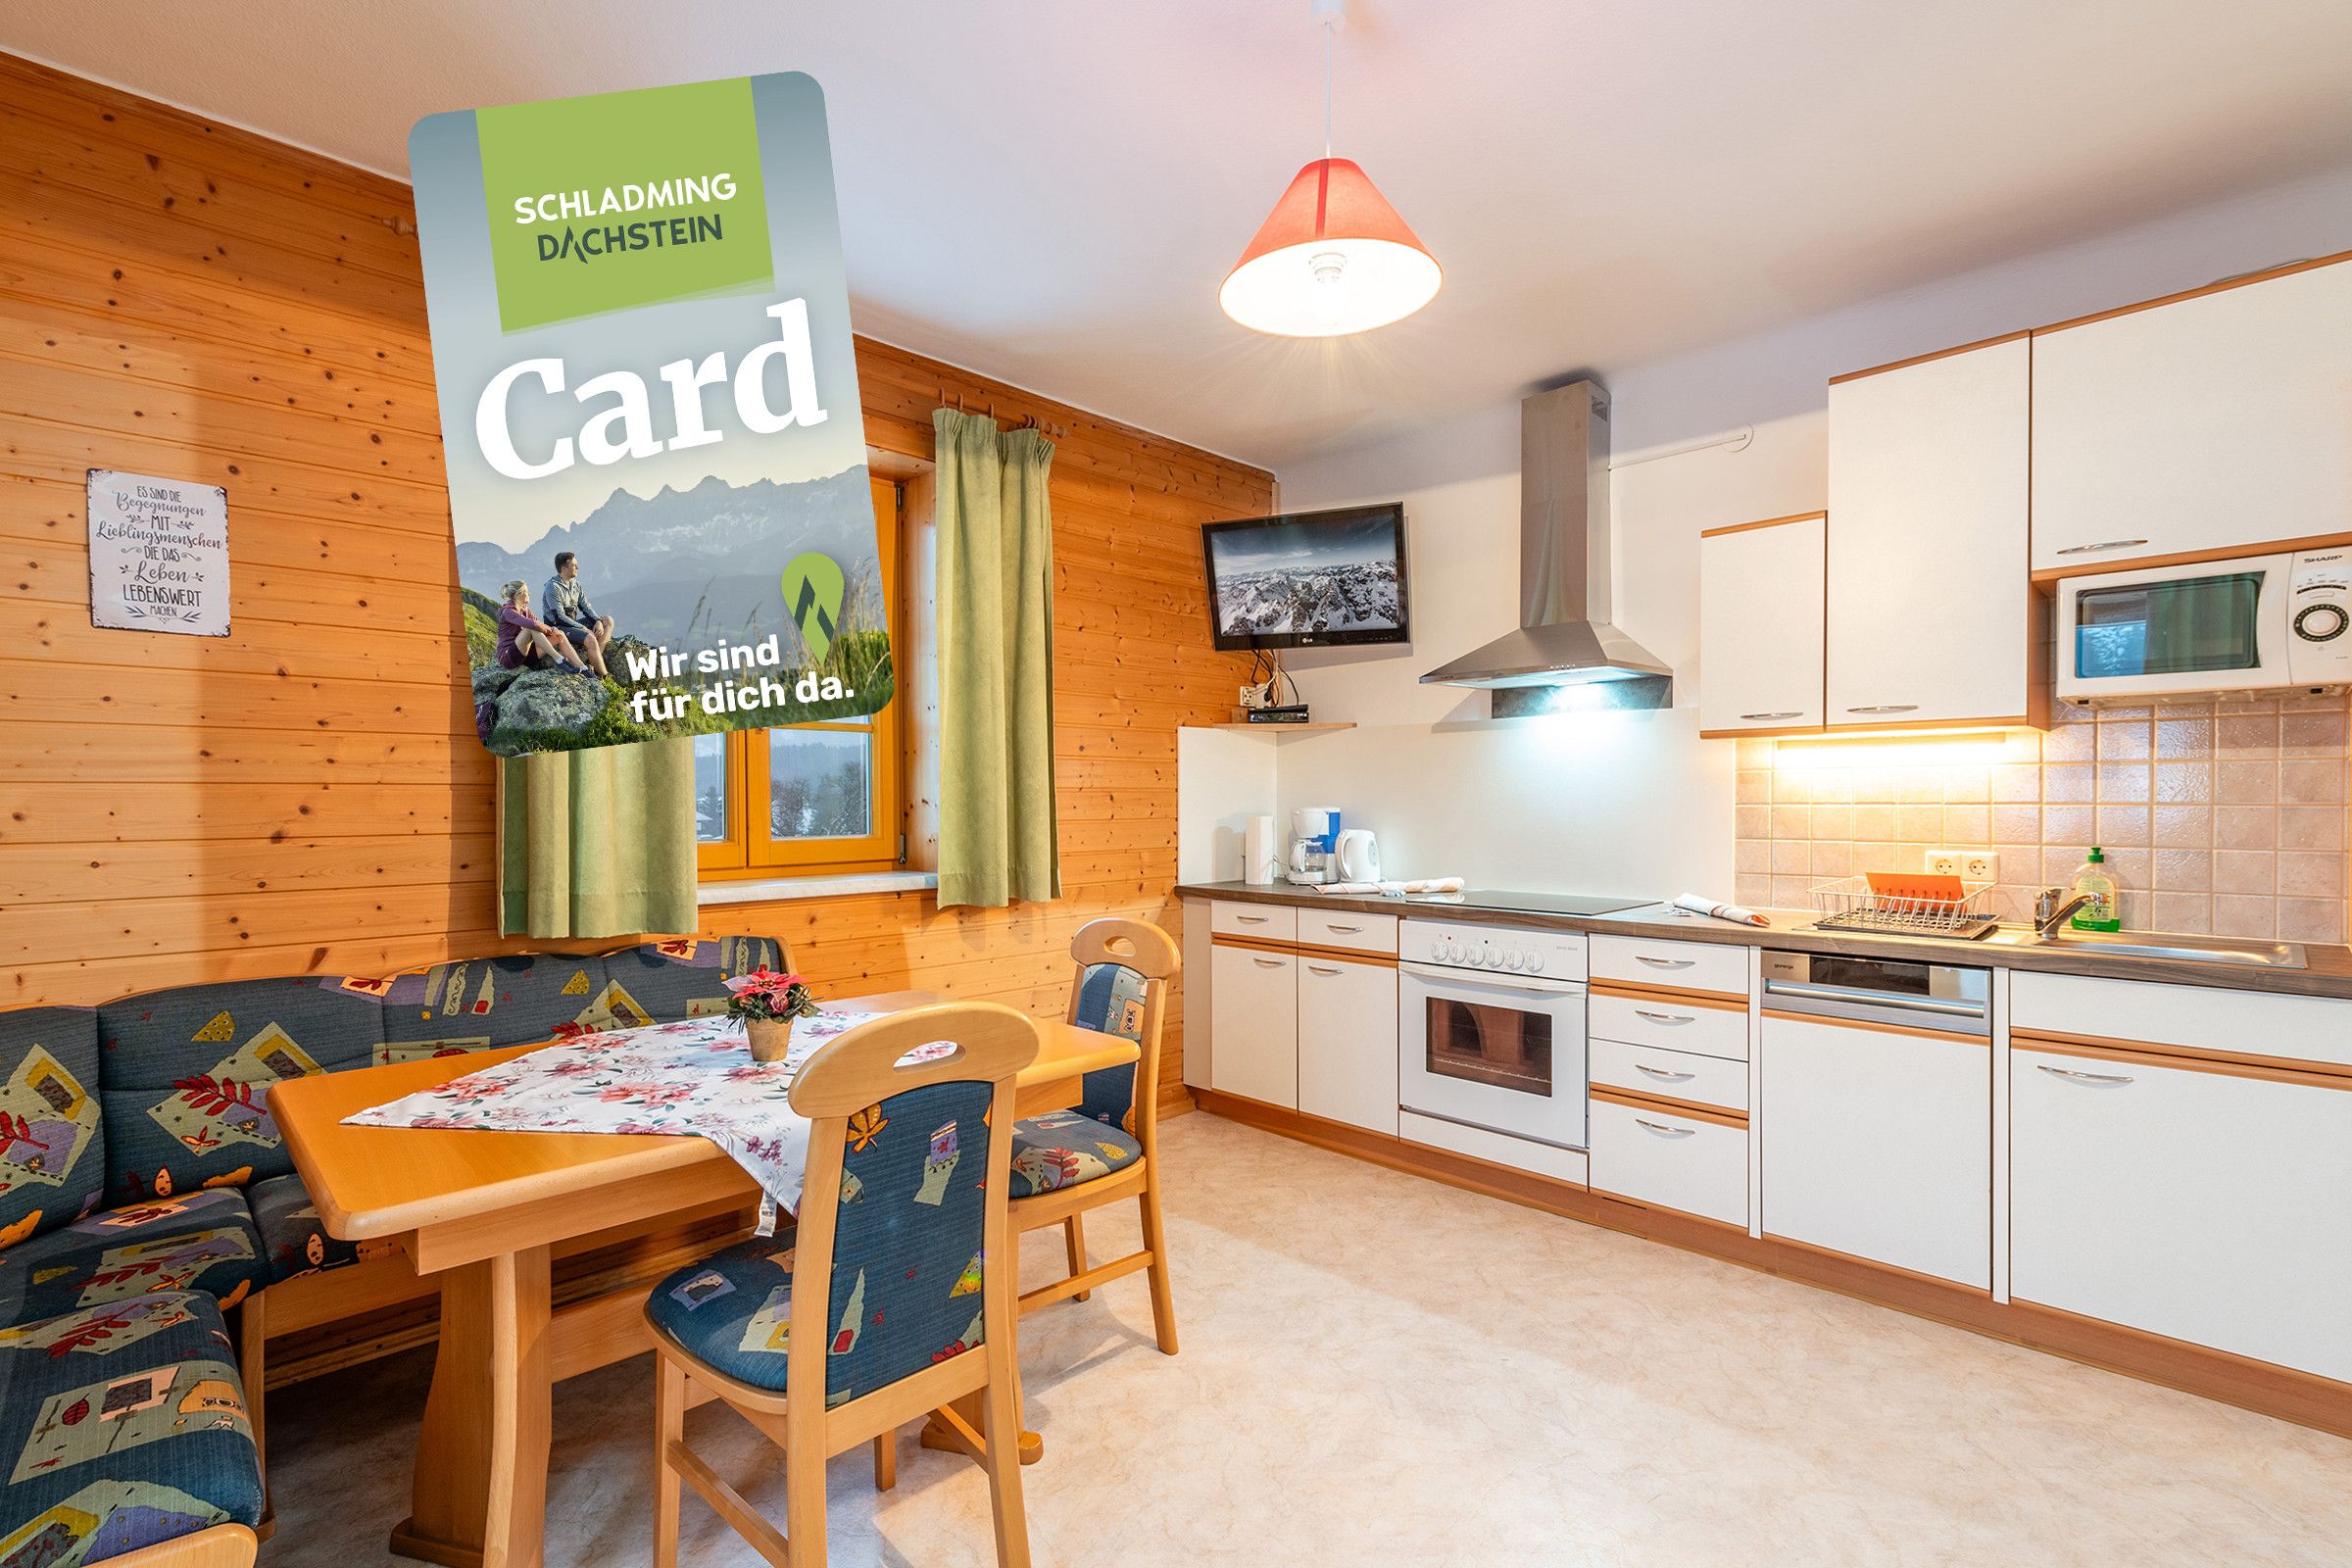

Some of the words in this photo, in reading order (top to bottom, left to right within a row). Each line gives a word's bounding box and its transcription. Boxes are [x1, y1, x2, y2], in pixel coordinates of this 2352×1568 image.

[137, 485, 148, 498] ES
[149, 487, 169, 501] SIND
[170, 490, 181, 503] DIE
[112, 490, 205, 518] Begegnungen
[150, 514, 172, 531] MIT
[96, 520, 221, 549] Lieblingsmenschen
[144, 545, 160, 561] DIE
[162, 548, 180, 563] DAS
[2304, 555, 2343, 564] SHARP
[134, 560, 189, 585] Leben
[122, 584, 202, 607] LEBENSWERT
[150, 605, 178, 617] MACHEN
